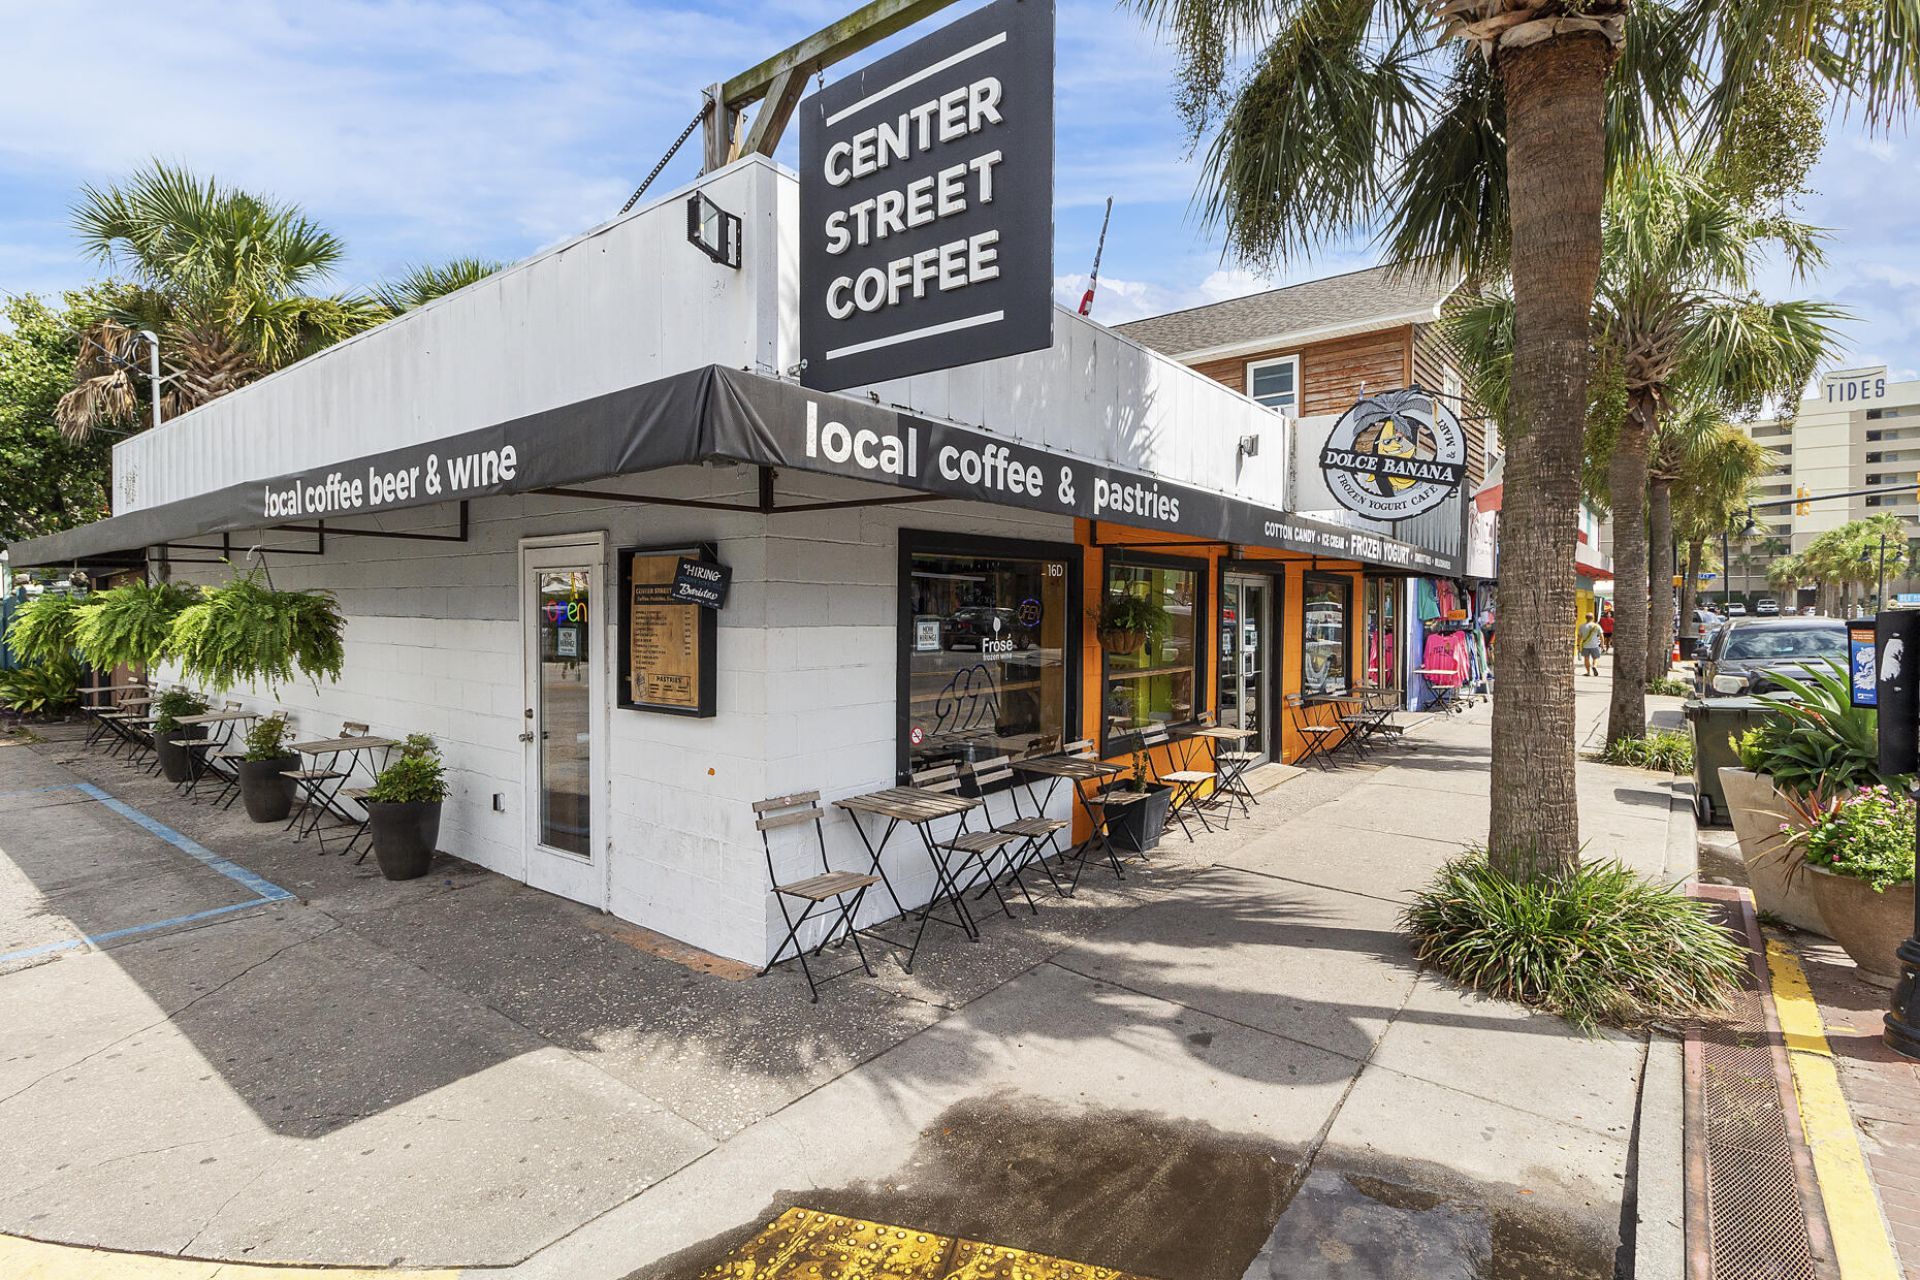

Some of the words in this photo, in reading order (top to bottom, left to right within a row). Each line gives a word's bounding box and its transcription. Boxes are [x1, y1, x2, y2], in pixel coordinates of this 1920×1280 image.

[824, 76, 1003, 187] CENTER
[825, 149, 1003, 255] STREET
[826, 229, 1000, 320] COFFEE
[1827, 378, 1885, 403] TIDES
[264, 479, 302, 518] local
[305, 472, 363, 513] coffee
[369, 466, 420, 505] beer
[425, 453, 442, 496] &
[447, 445, 517, 491] wine
[805, 400, 917, 478] local
[938, 443, 1043, 498] coffee
[1058, 465, 1076, 506] &
[1093, 476, 1180, 523] pastries
[1325, 451, 1379, 471] DOLCE
[1382, 458, 1455, 482] BANANA
[1338, 473, 1367, 505] FROZEN
[1368, 500, 1407, 511] YOGURT
[1411, 485, 1438, 506] CAFE
[1436, 419, 1456, 447] MART
[1047, 564, 1063, 577] 16D
[1264, 520, 1293, 541] COTTON
[1294, 527, 1316, 544] CANDY
[1330, 535, 1345, 550] CREAM
[1351, 534, 1382, 560] FROZEN
[1383, 541, 1410, 565] YOGURT
[683, 563, 722, 582] HIRING
[982, 633, 1013, 653] Frosé
